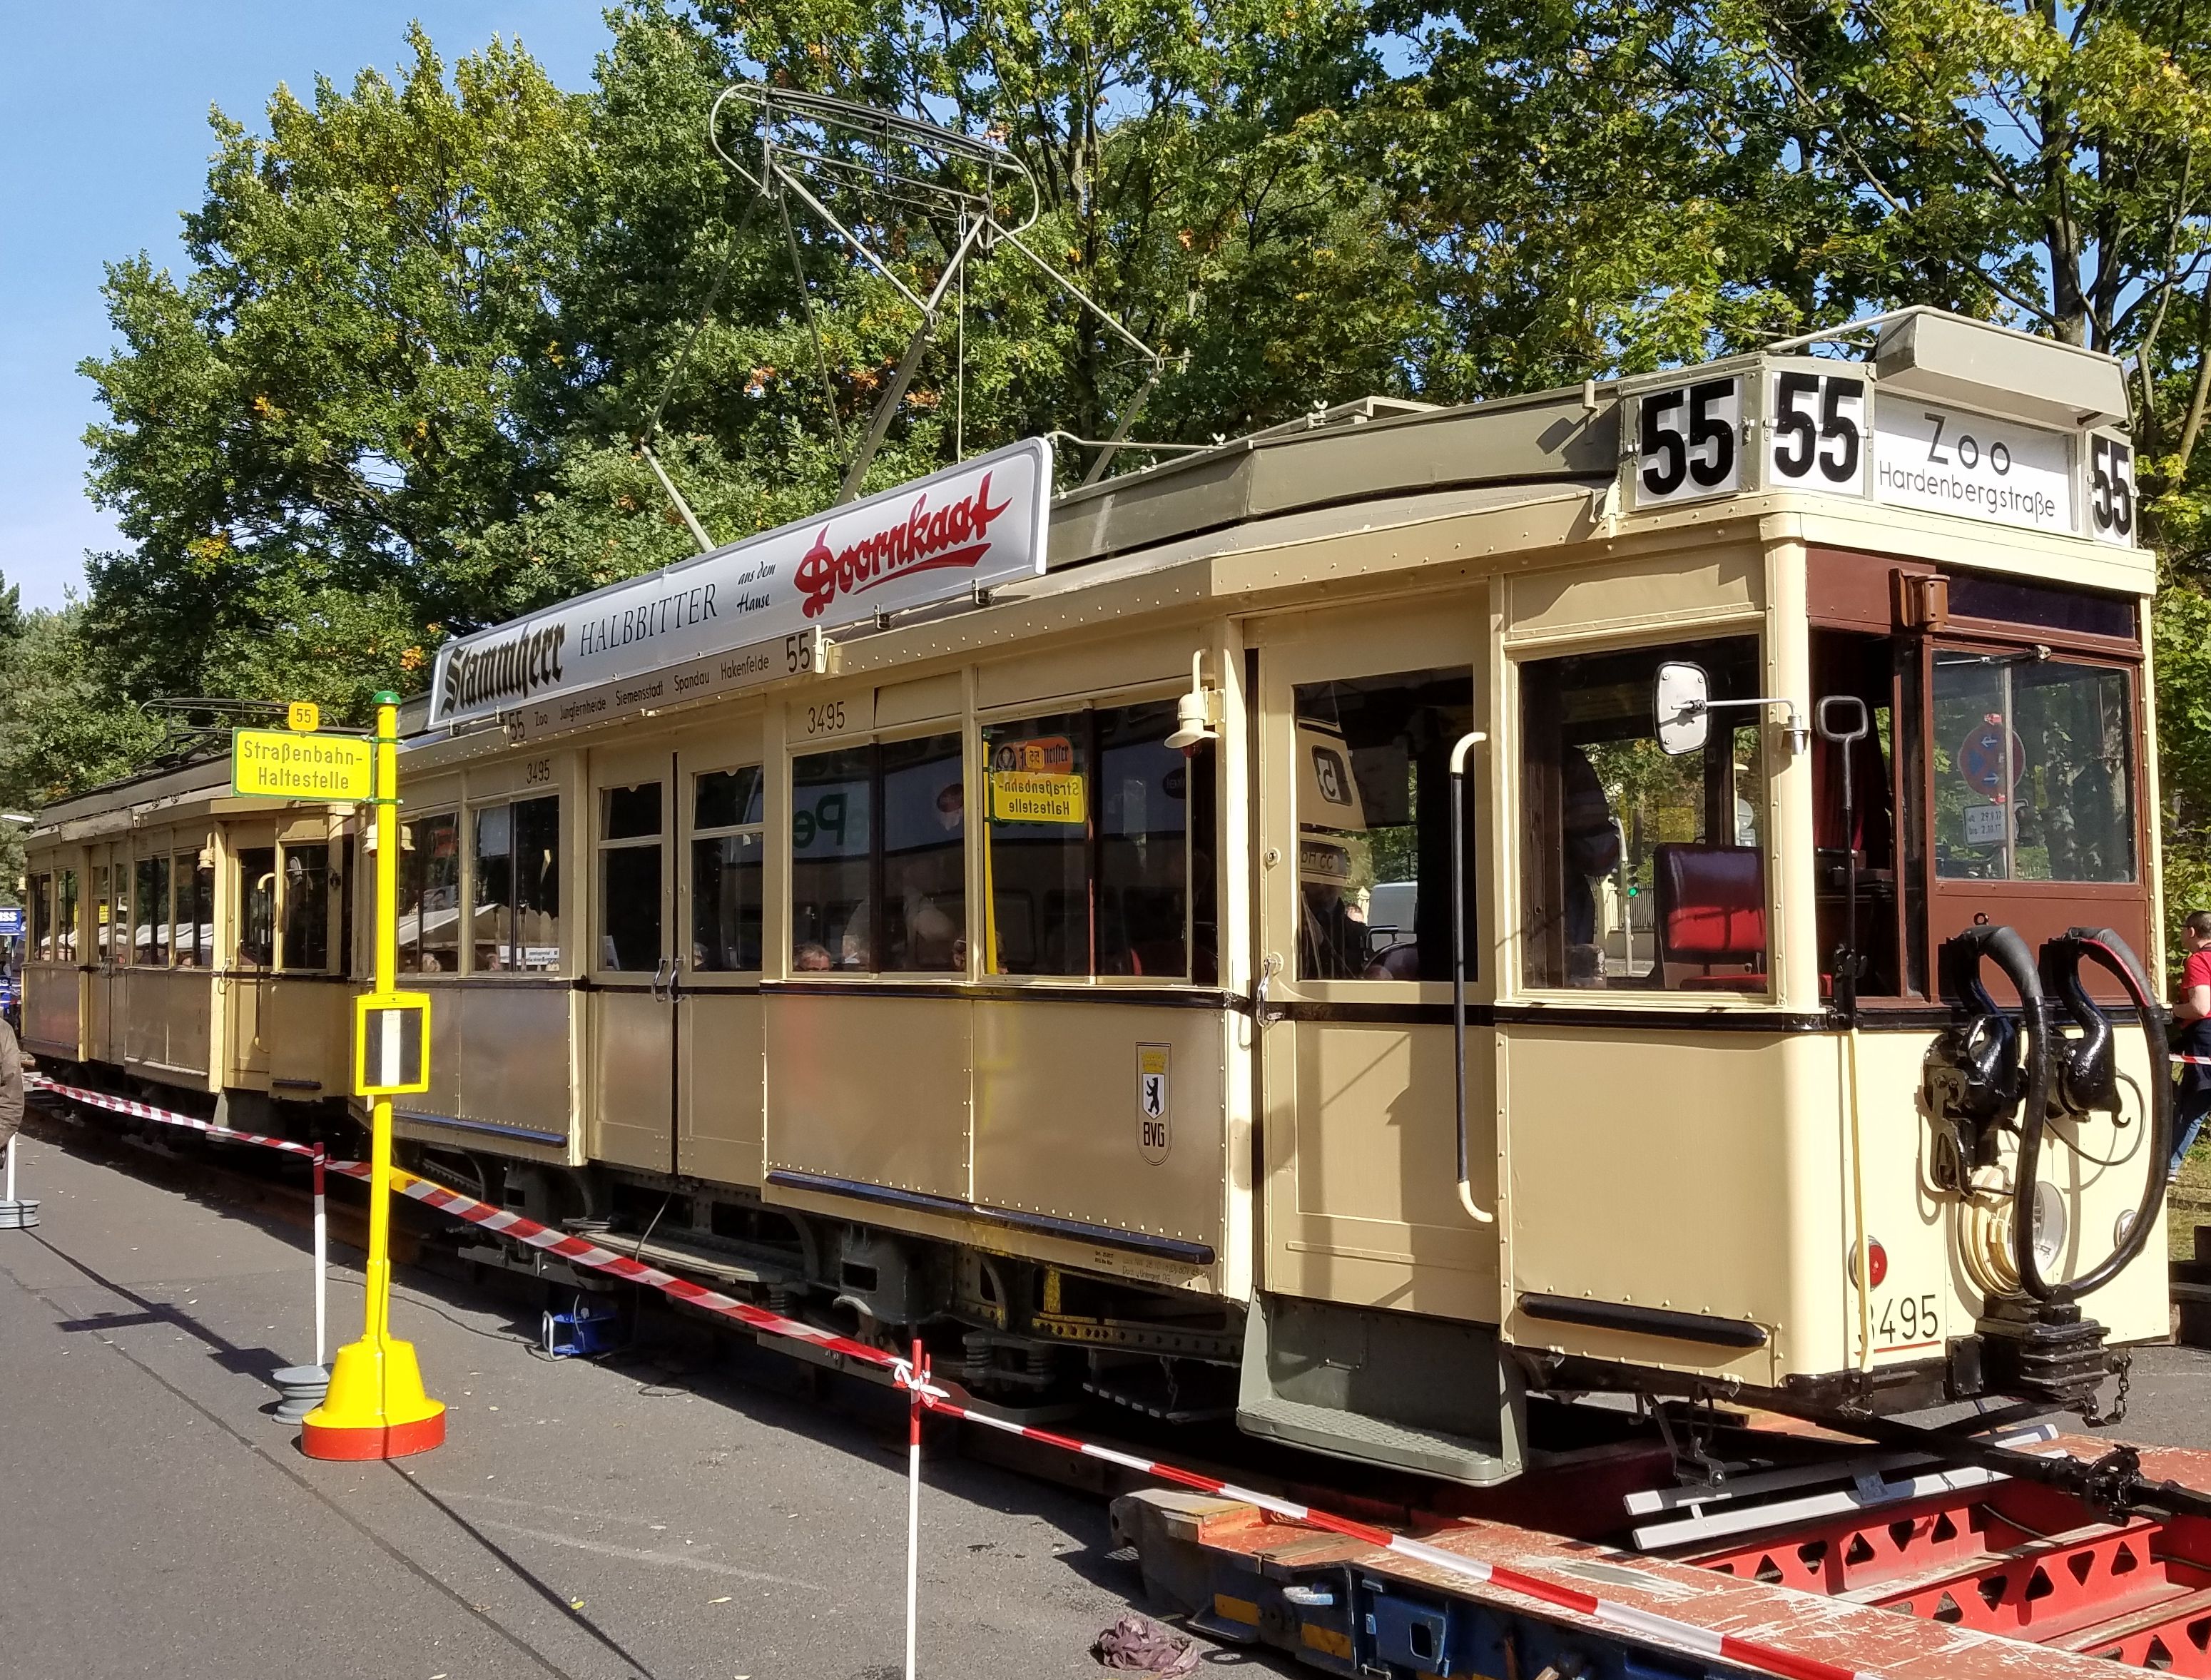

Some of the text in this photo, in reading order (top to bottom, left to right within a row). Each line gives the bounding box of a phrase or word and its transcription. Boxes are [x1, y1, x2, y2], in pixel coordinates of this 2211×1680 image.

[1642, 378, 1734, 495] 55
[1774, 371, 1864, 483] 55
[1924, 412, 2011, 475] Zoo
[1879, 460, 2055, 523] Hardenbergstraße
[2091, 433, 2132, 536] 55
[738, 561, 776, 586] aus dem
[793, 469, 1013, 618] Doornkaat
[579, 583, 718, 656] HALBBITTER
[736, 591, 770, 614] Hause
[440, 622, 565, 716] Stammherr
[507, 632, 810, 740] 55 Zoo Jungfernheide Siemensstadt Spandau Hakenfelde 55
[296, 708, 311, 723] 55
[807, 701, 845, 734] 3495
[244, 740, 362, 765] Straßenbahn-
[258, 767, 349, 789] Haltestelle
[527, 759, 550, 784] 3495
[1143, 1121, 1165, 1148] BVG
